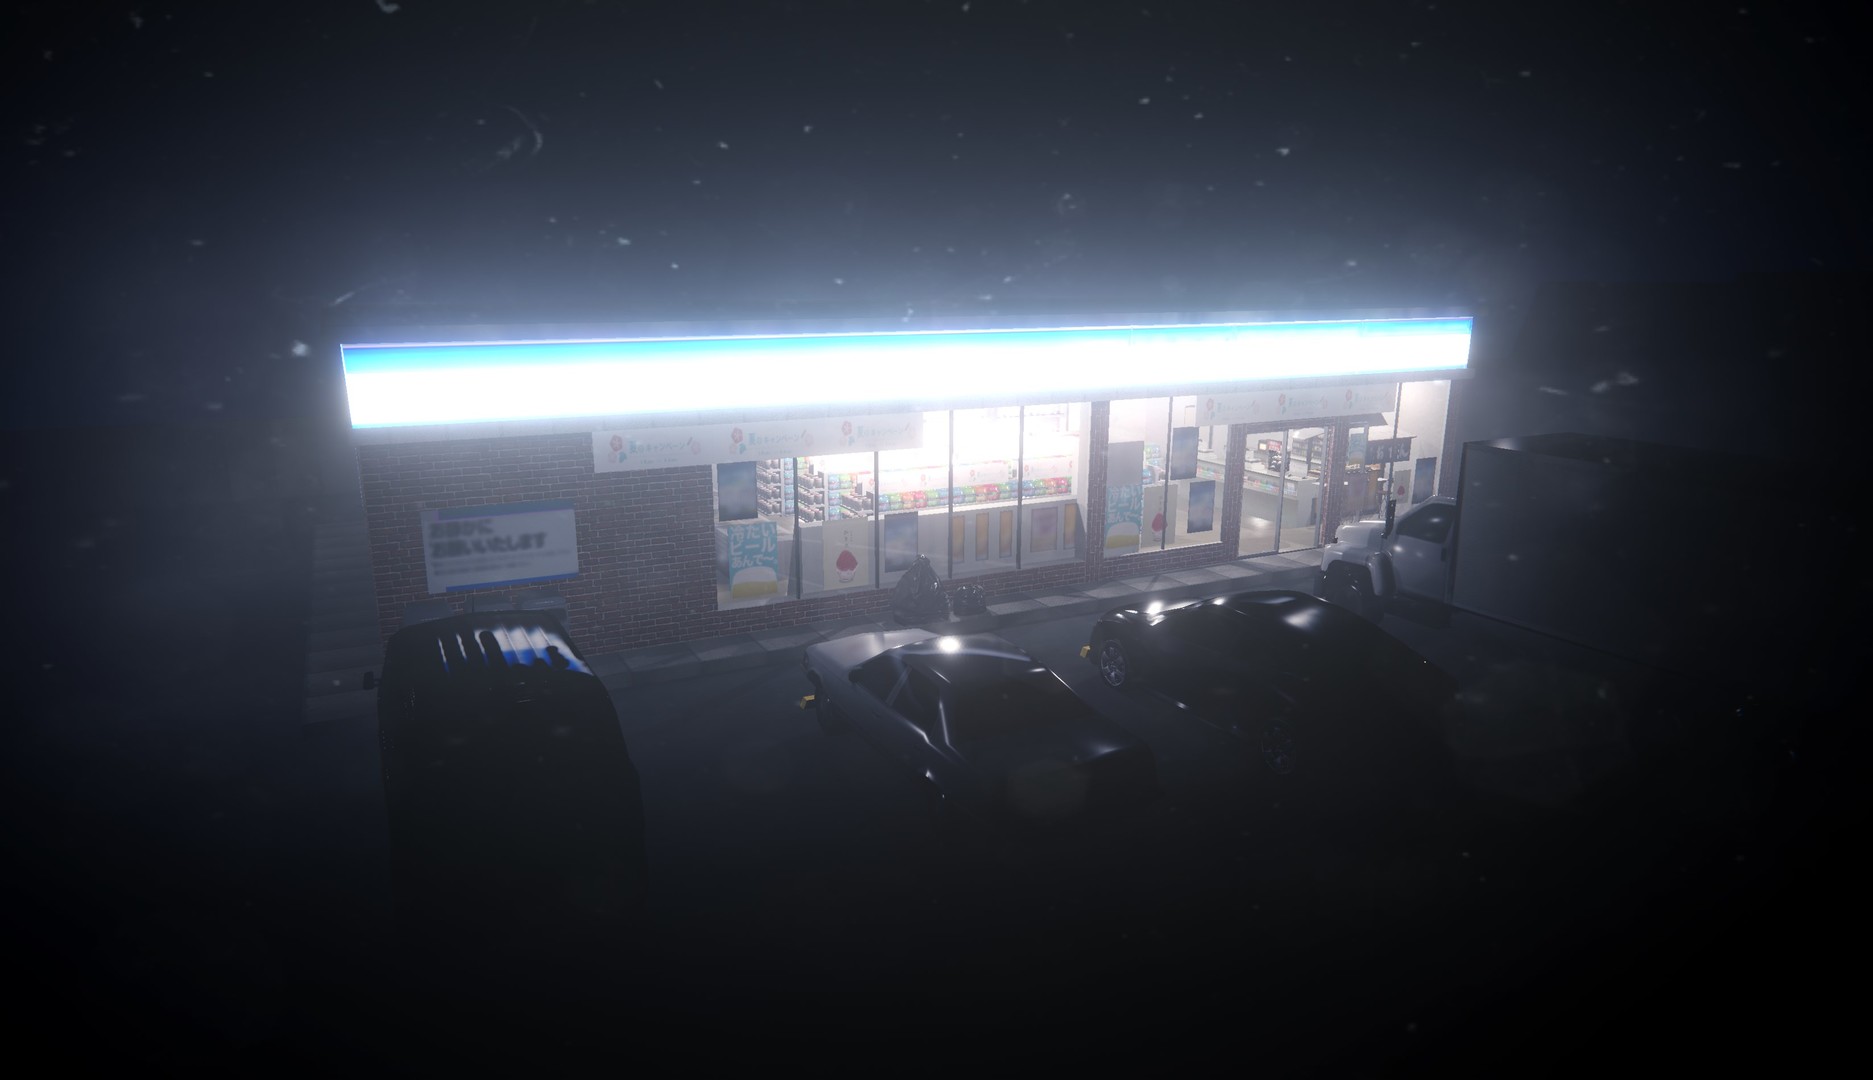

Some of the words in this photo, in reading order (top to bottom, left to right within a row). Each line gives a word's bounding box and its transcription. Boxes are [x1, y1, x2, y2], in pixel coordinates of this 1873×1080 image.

[729, 522, 776, 544] 冷たい
[730, 538, 776, 557] ビール
